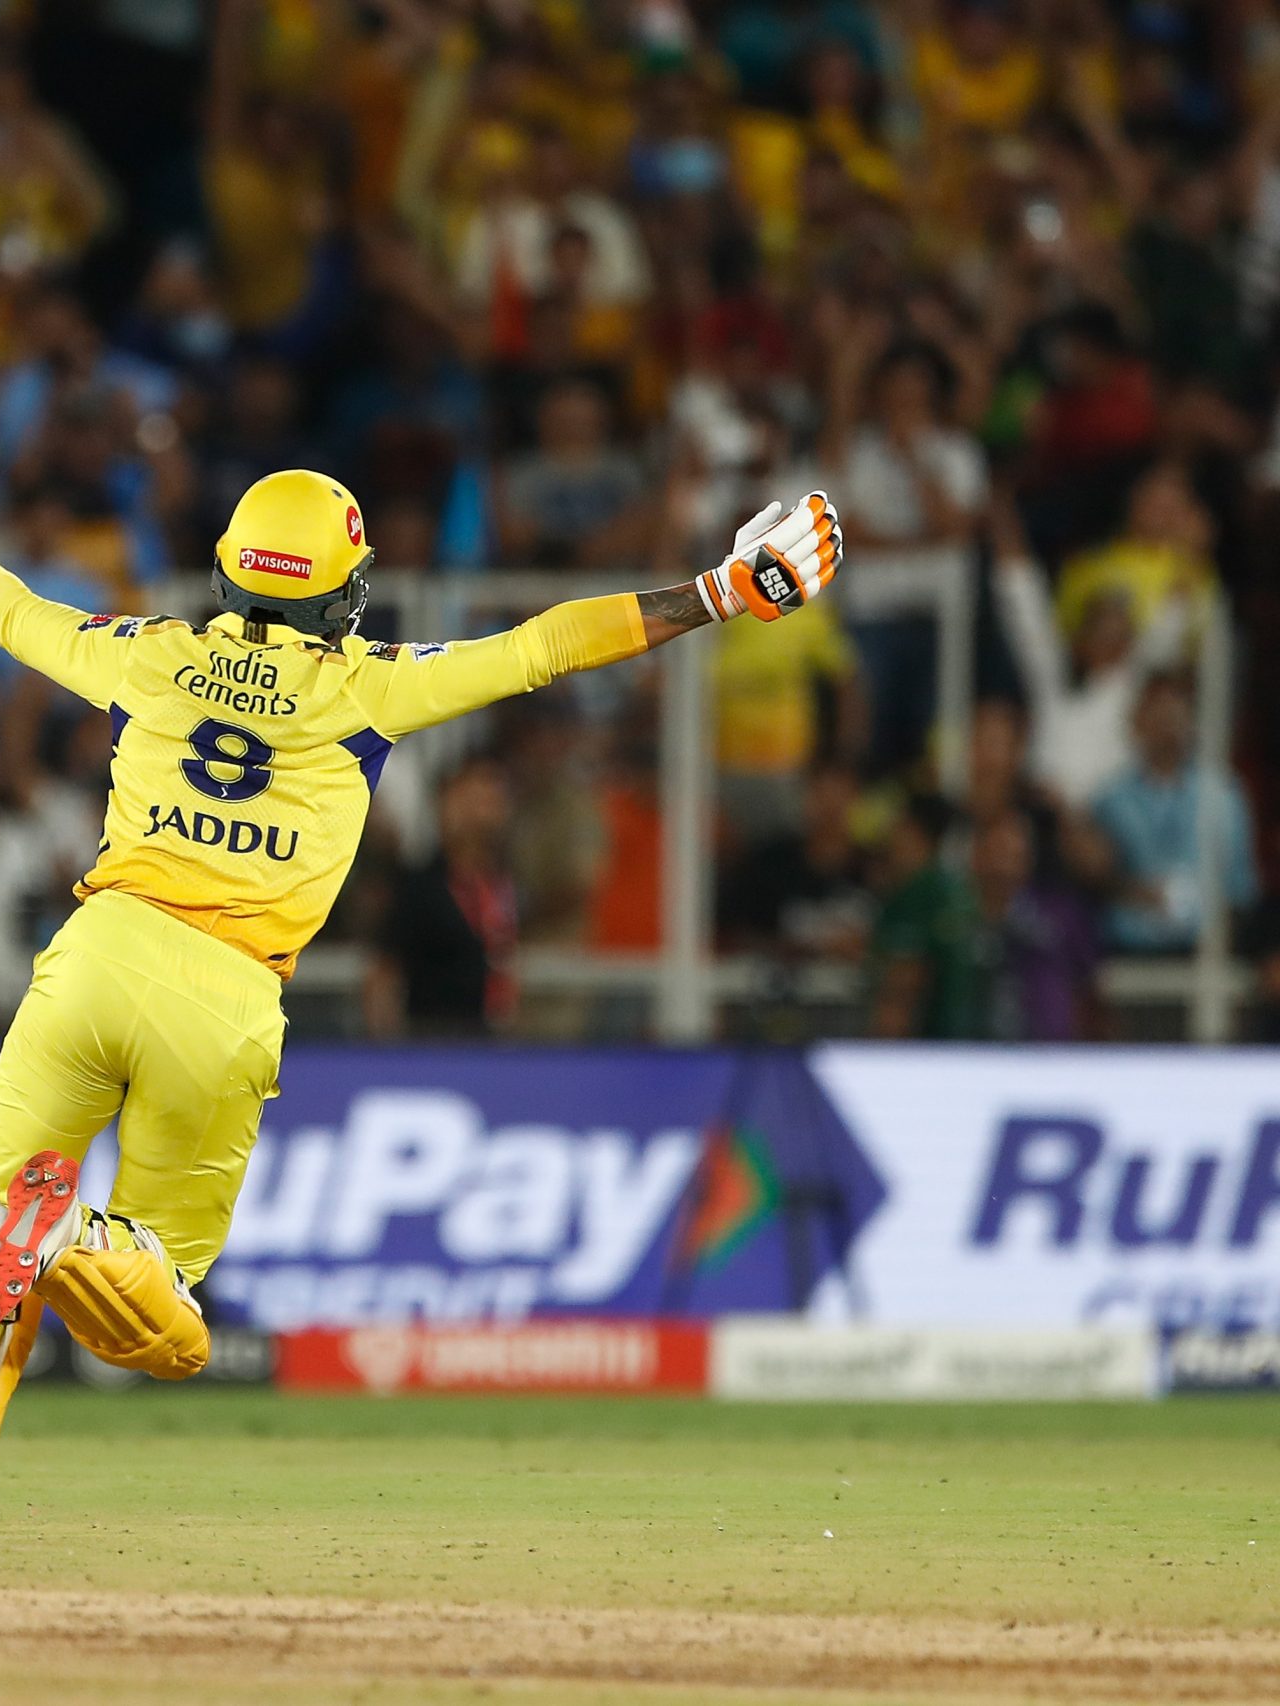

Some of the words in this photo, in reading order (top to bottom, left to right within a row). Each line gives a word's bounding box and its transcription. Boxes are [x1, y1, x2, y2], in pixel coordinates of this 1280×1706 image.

[257, 555, 311, 575] VISION11
[758, 566, 791, 602] SS
[209, 649, 278, 690] India
[179, 717, 276, 804] 8
[143, 804, 299, 862] JADDU
[220, 1088, 702, 1306] uPay
